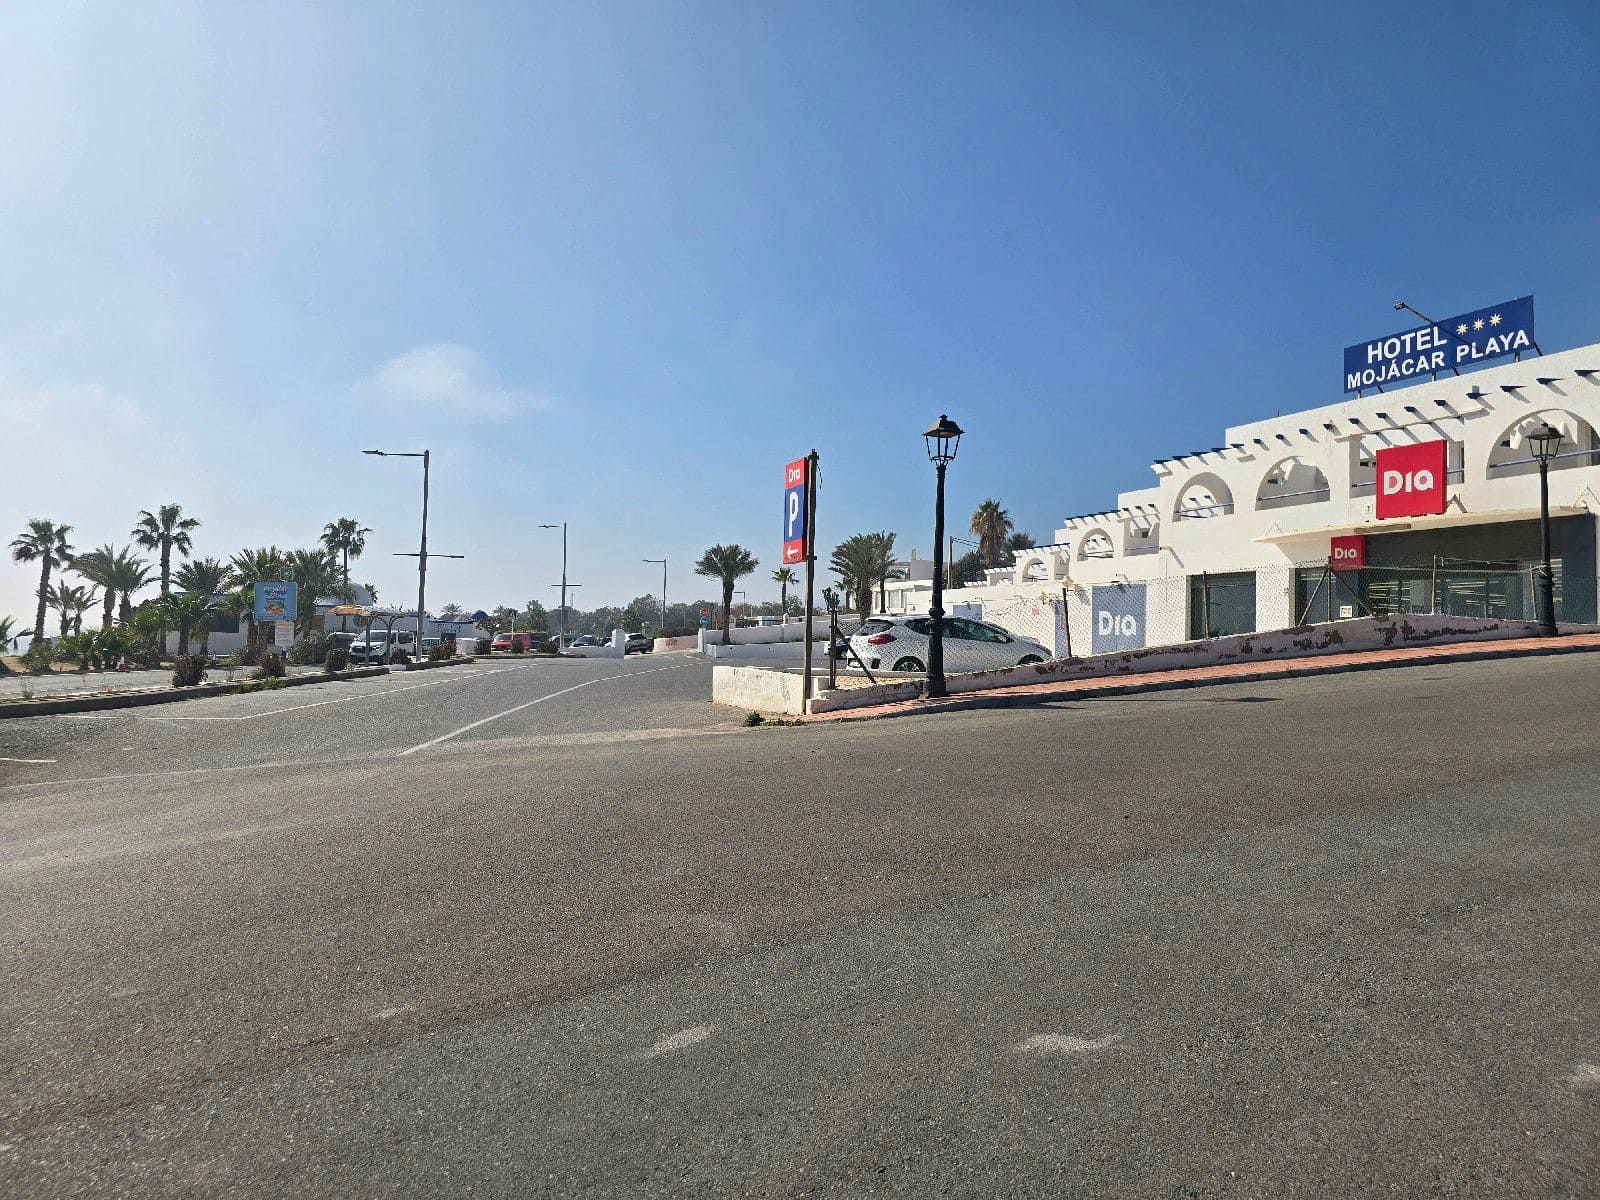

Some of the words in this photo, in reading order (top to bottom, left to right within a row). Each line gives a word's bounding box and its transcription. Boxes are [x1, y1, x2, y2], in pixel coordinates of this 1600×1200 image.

[1347, 351, 1445, 389] MOJÁCAR
[1456, 329, 1530, 363] PLAYA
[1367, 326, 1447, 364] HOTEL
[788, 491, 799, 537] P
